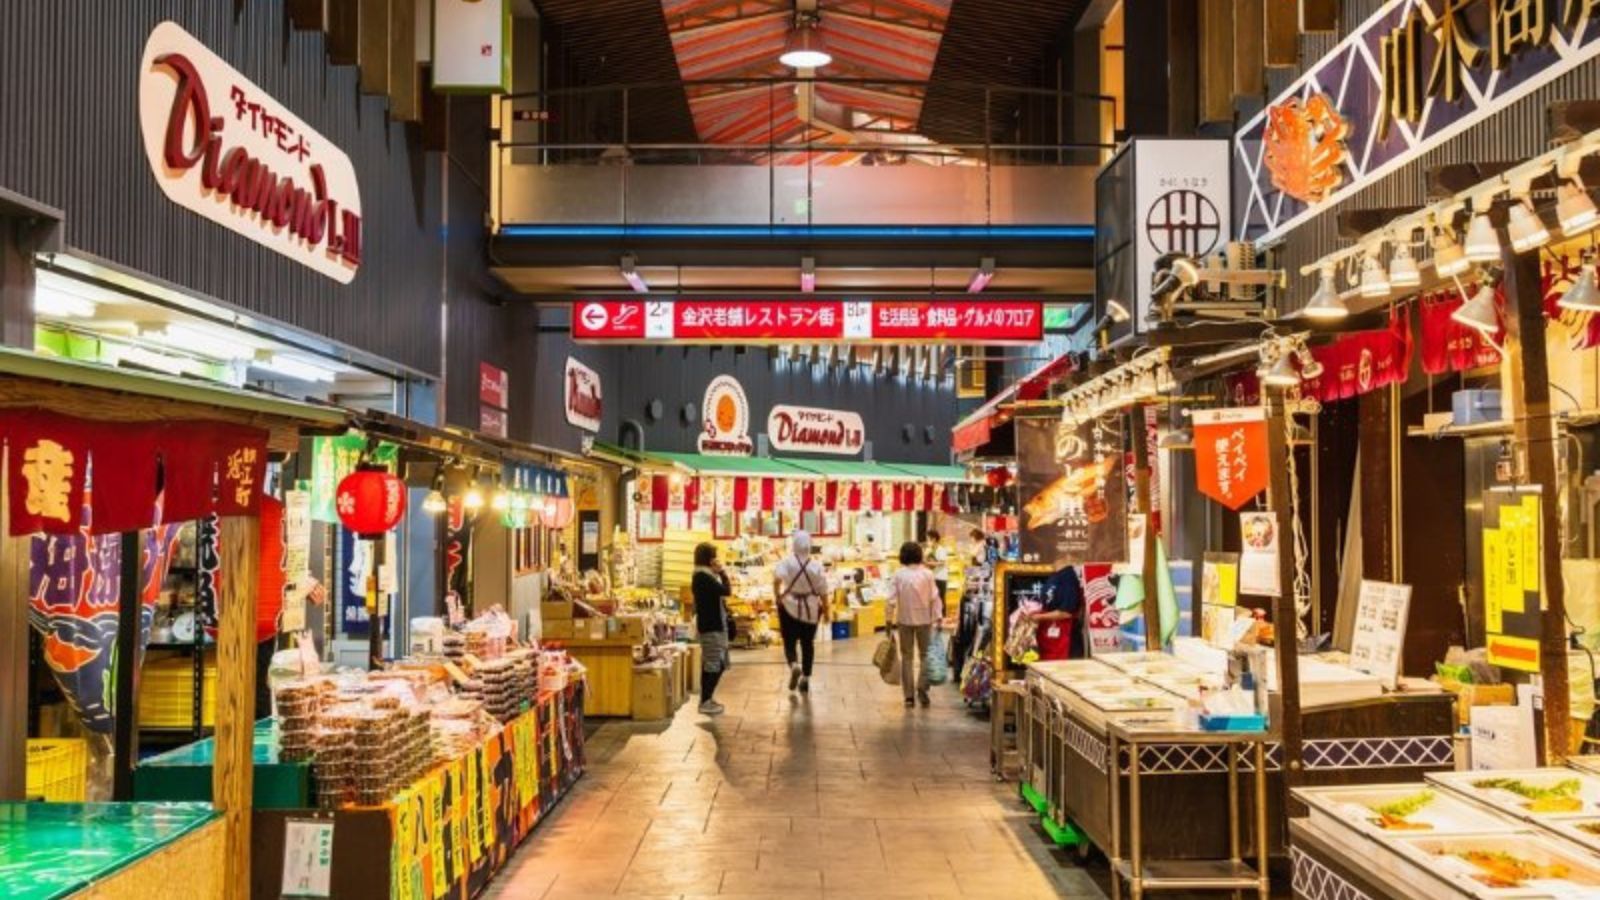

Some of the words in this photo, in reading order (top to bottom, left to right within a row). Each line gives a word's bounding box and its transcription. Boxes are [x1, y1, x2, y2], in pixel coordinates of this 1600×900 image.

[152, 53, 328, 247] Diamond
[230, 85, 311, 162] ダイヤモンド
[681, 306, 834, 328] 金沢老舗レストラン街
[773, 411, 845, 447] Diamond
[1231, 427, 1248, 481] ペイペイ
[1215, 436, 1233, 499] 使えます。
